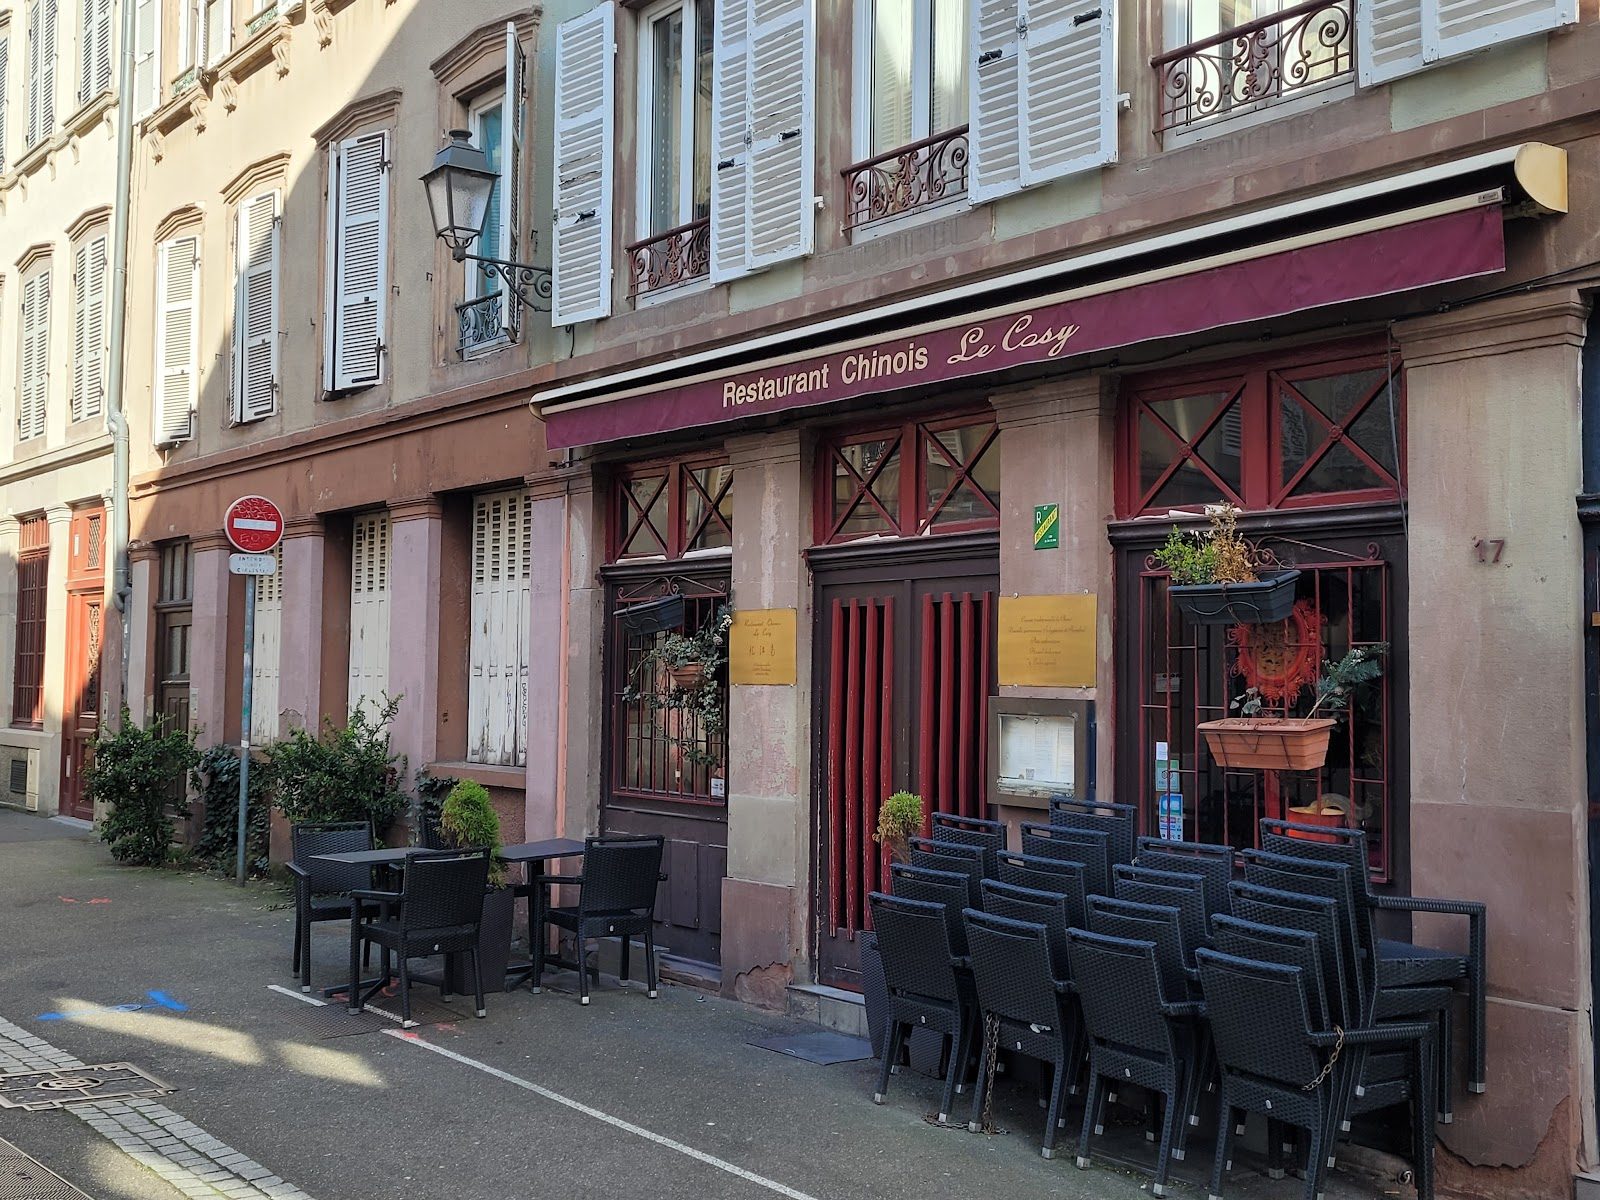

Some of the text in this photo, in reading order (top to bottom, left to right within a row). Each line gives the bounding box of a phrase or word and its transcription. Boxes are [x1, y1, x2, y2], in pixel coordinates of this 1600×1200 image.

[723, 315, 1080, 408] Restaurant Chinois Le Cosy
[1036, 511, 1042, 525] R
[1474, 538, 1504, 563] 17
